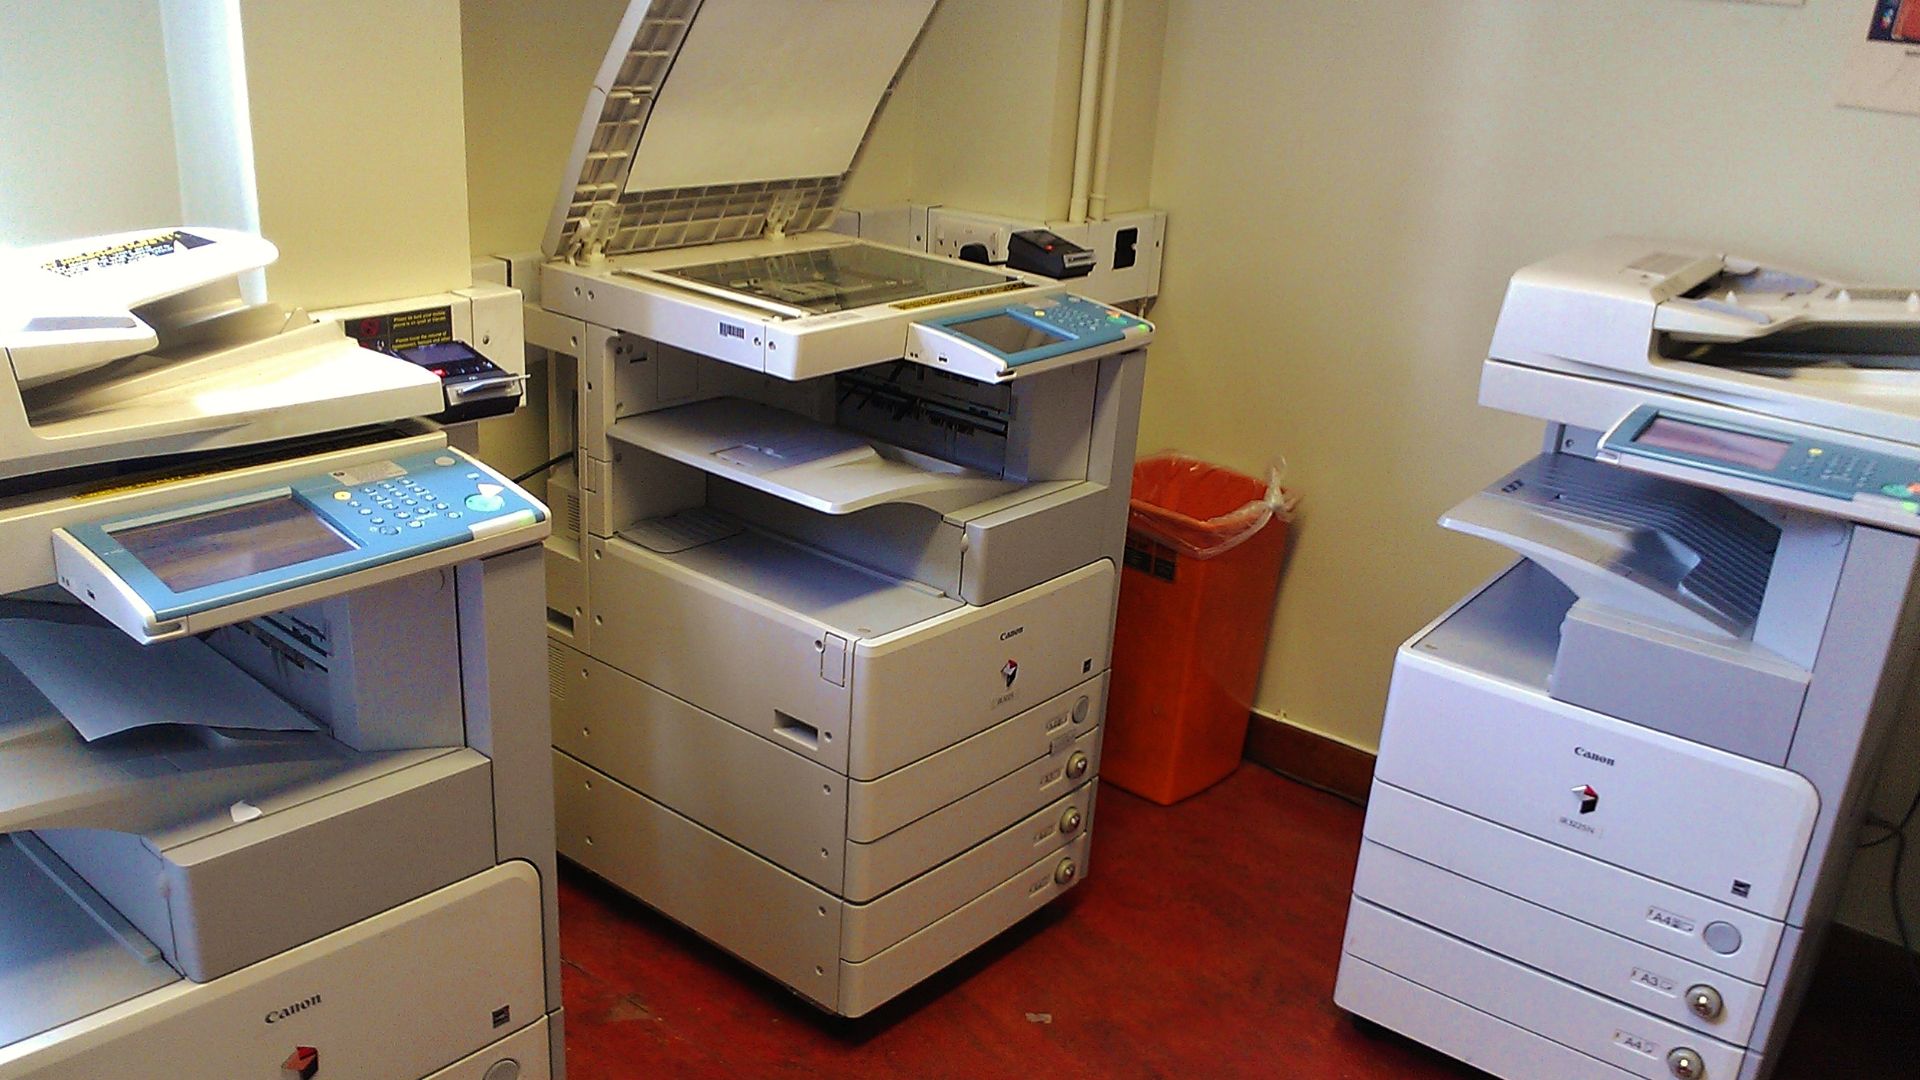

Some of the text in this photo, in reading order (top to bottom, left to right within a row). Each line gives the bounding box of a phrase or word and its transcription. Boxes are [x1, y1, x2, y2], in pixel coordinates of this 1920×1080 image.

[1573, 746, 1616, 767] Canon
[1640, 973, 1659, 987] A3
[265, 994, 322, 1024] Canon
